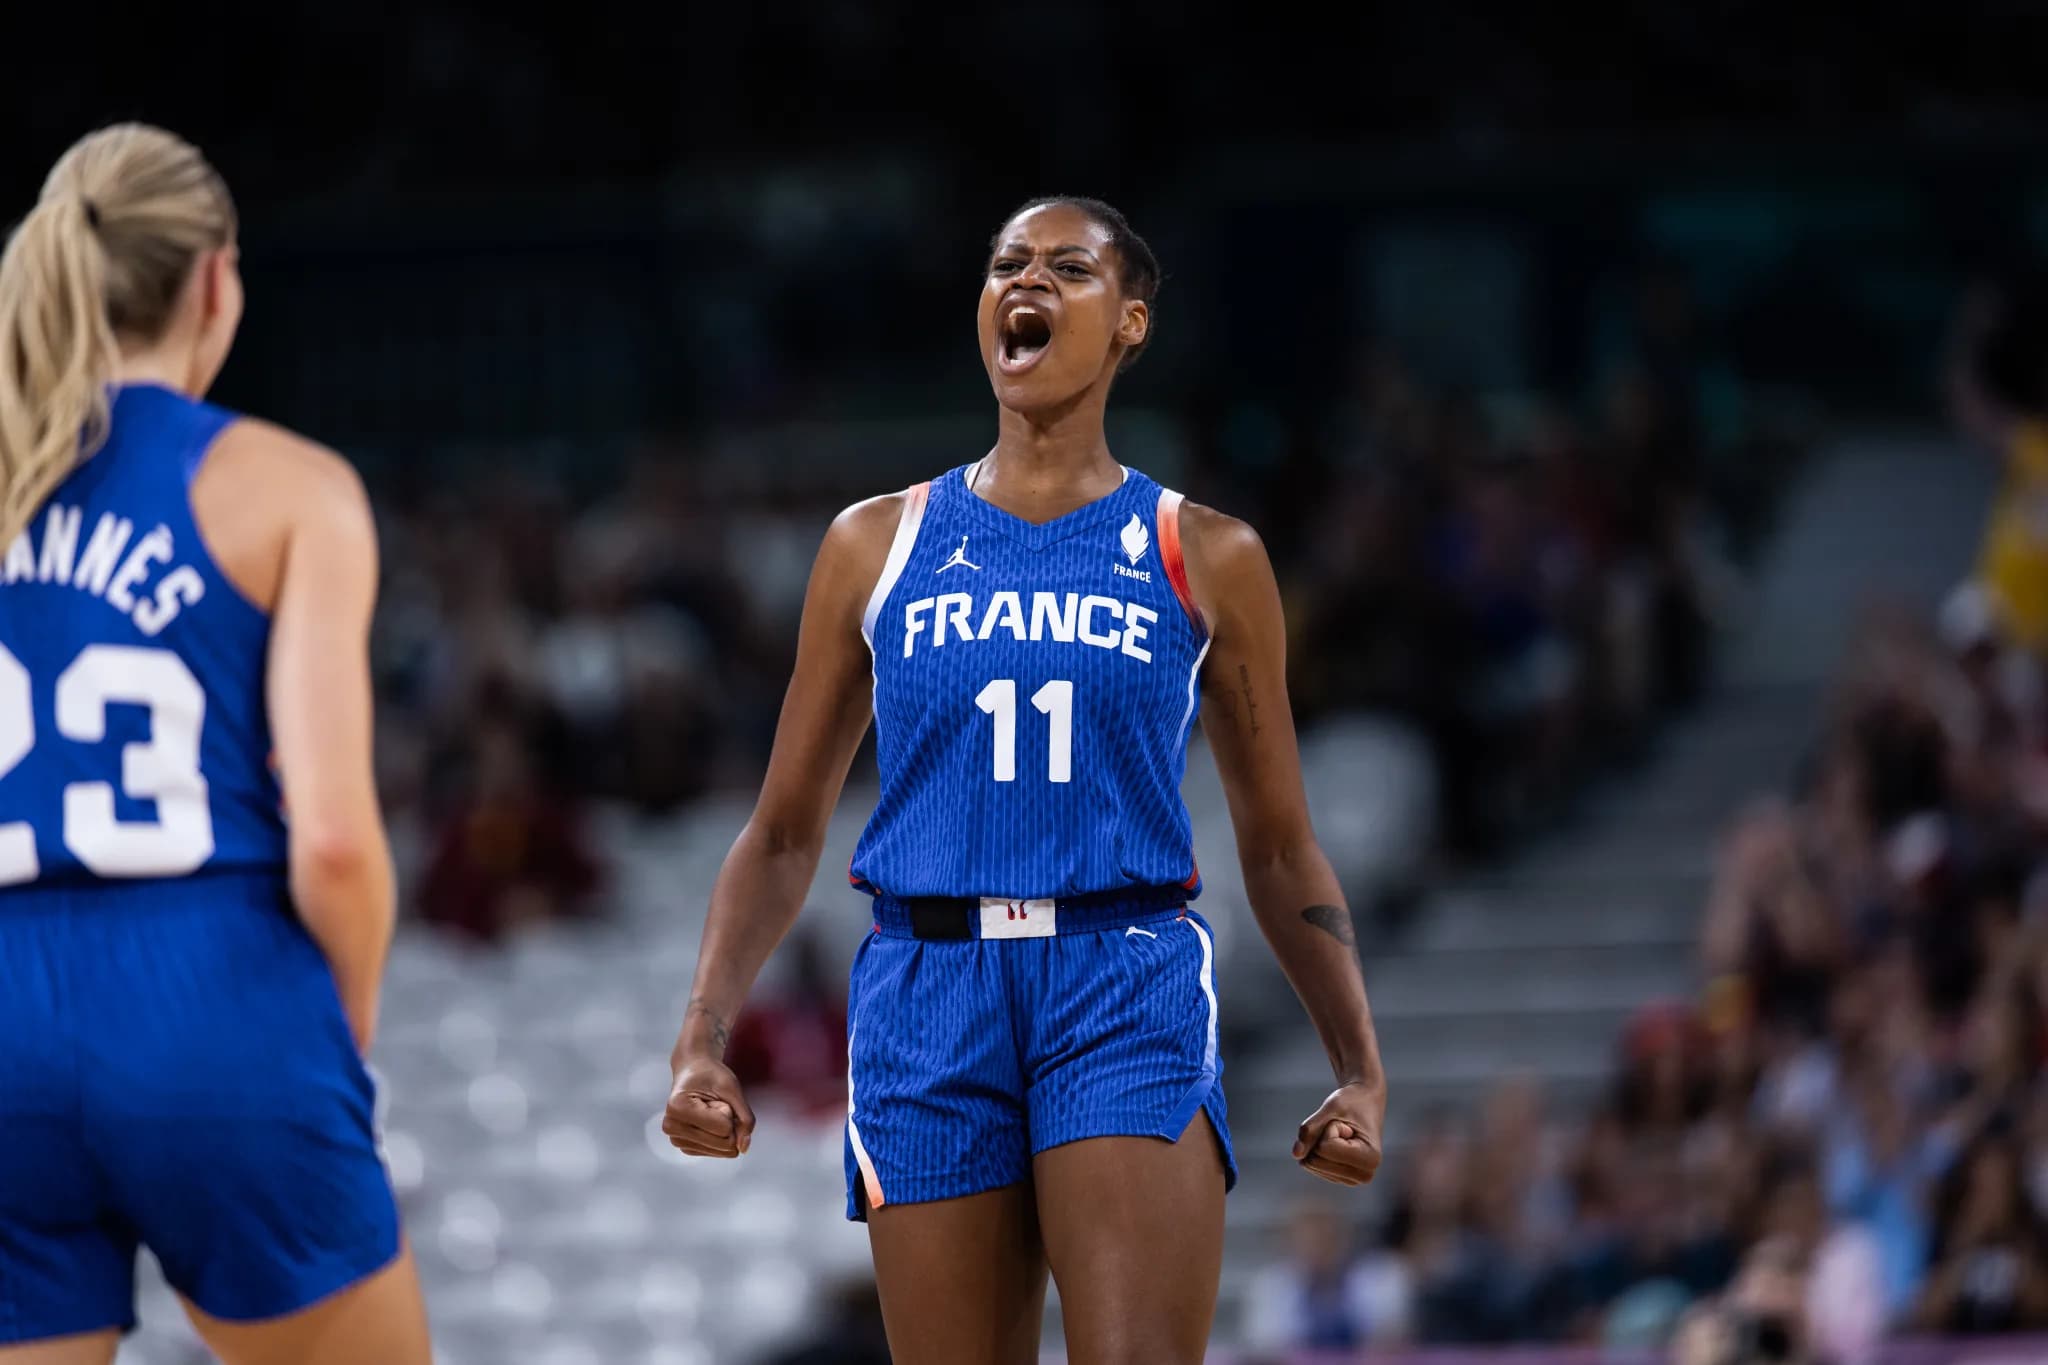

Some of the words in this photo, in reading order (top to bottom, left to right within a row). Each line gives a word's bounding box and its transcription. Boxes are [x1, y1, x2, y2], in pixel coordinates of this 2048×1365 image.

[0, 502, 205, 636] ANNÈS
[1114, 563, 1151, 583] FRANCE
[903, 591, 1159, 664] FRANCE
[974, 679, 1074, 783] 11
